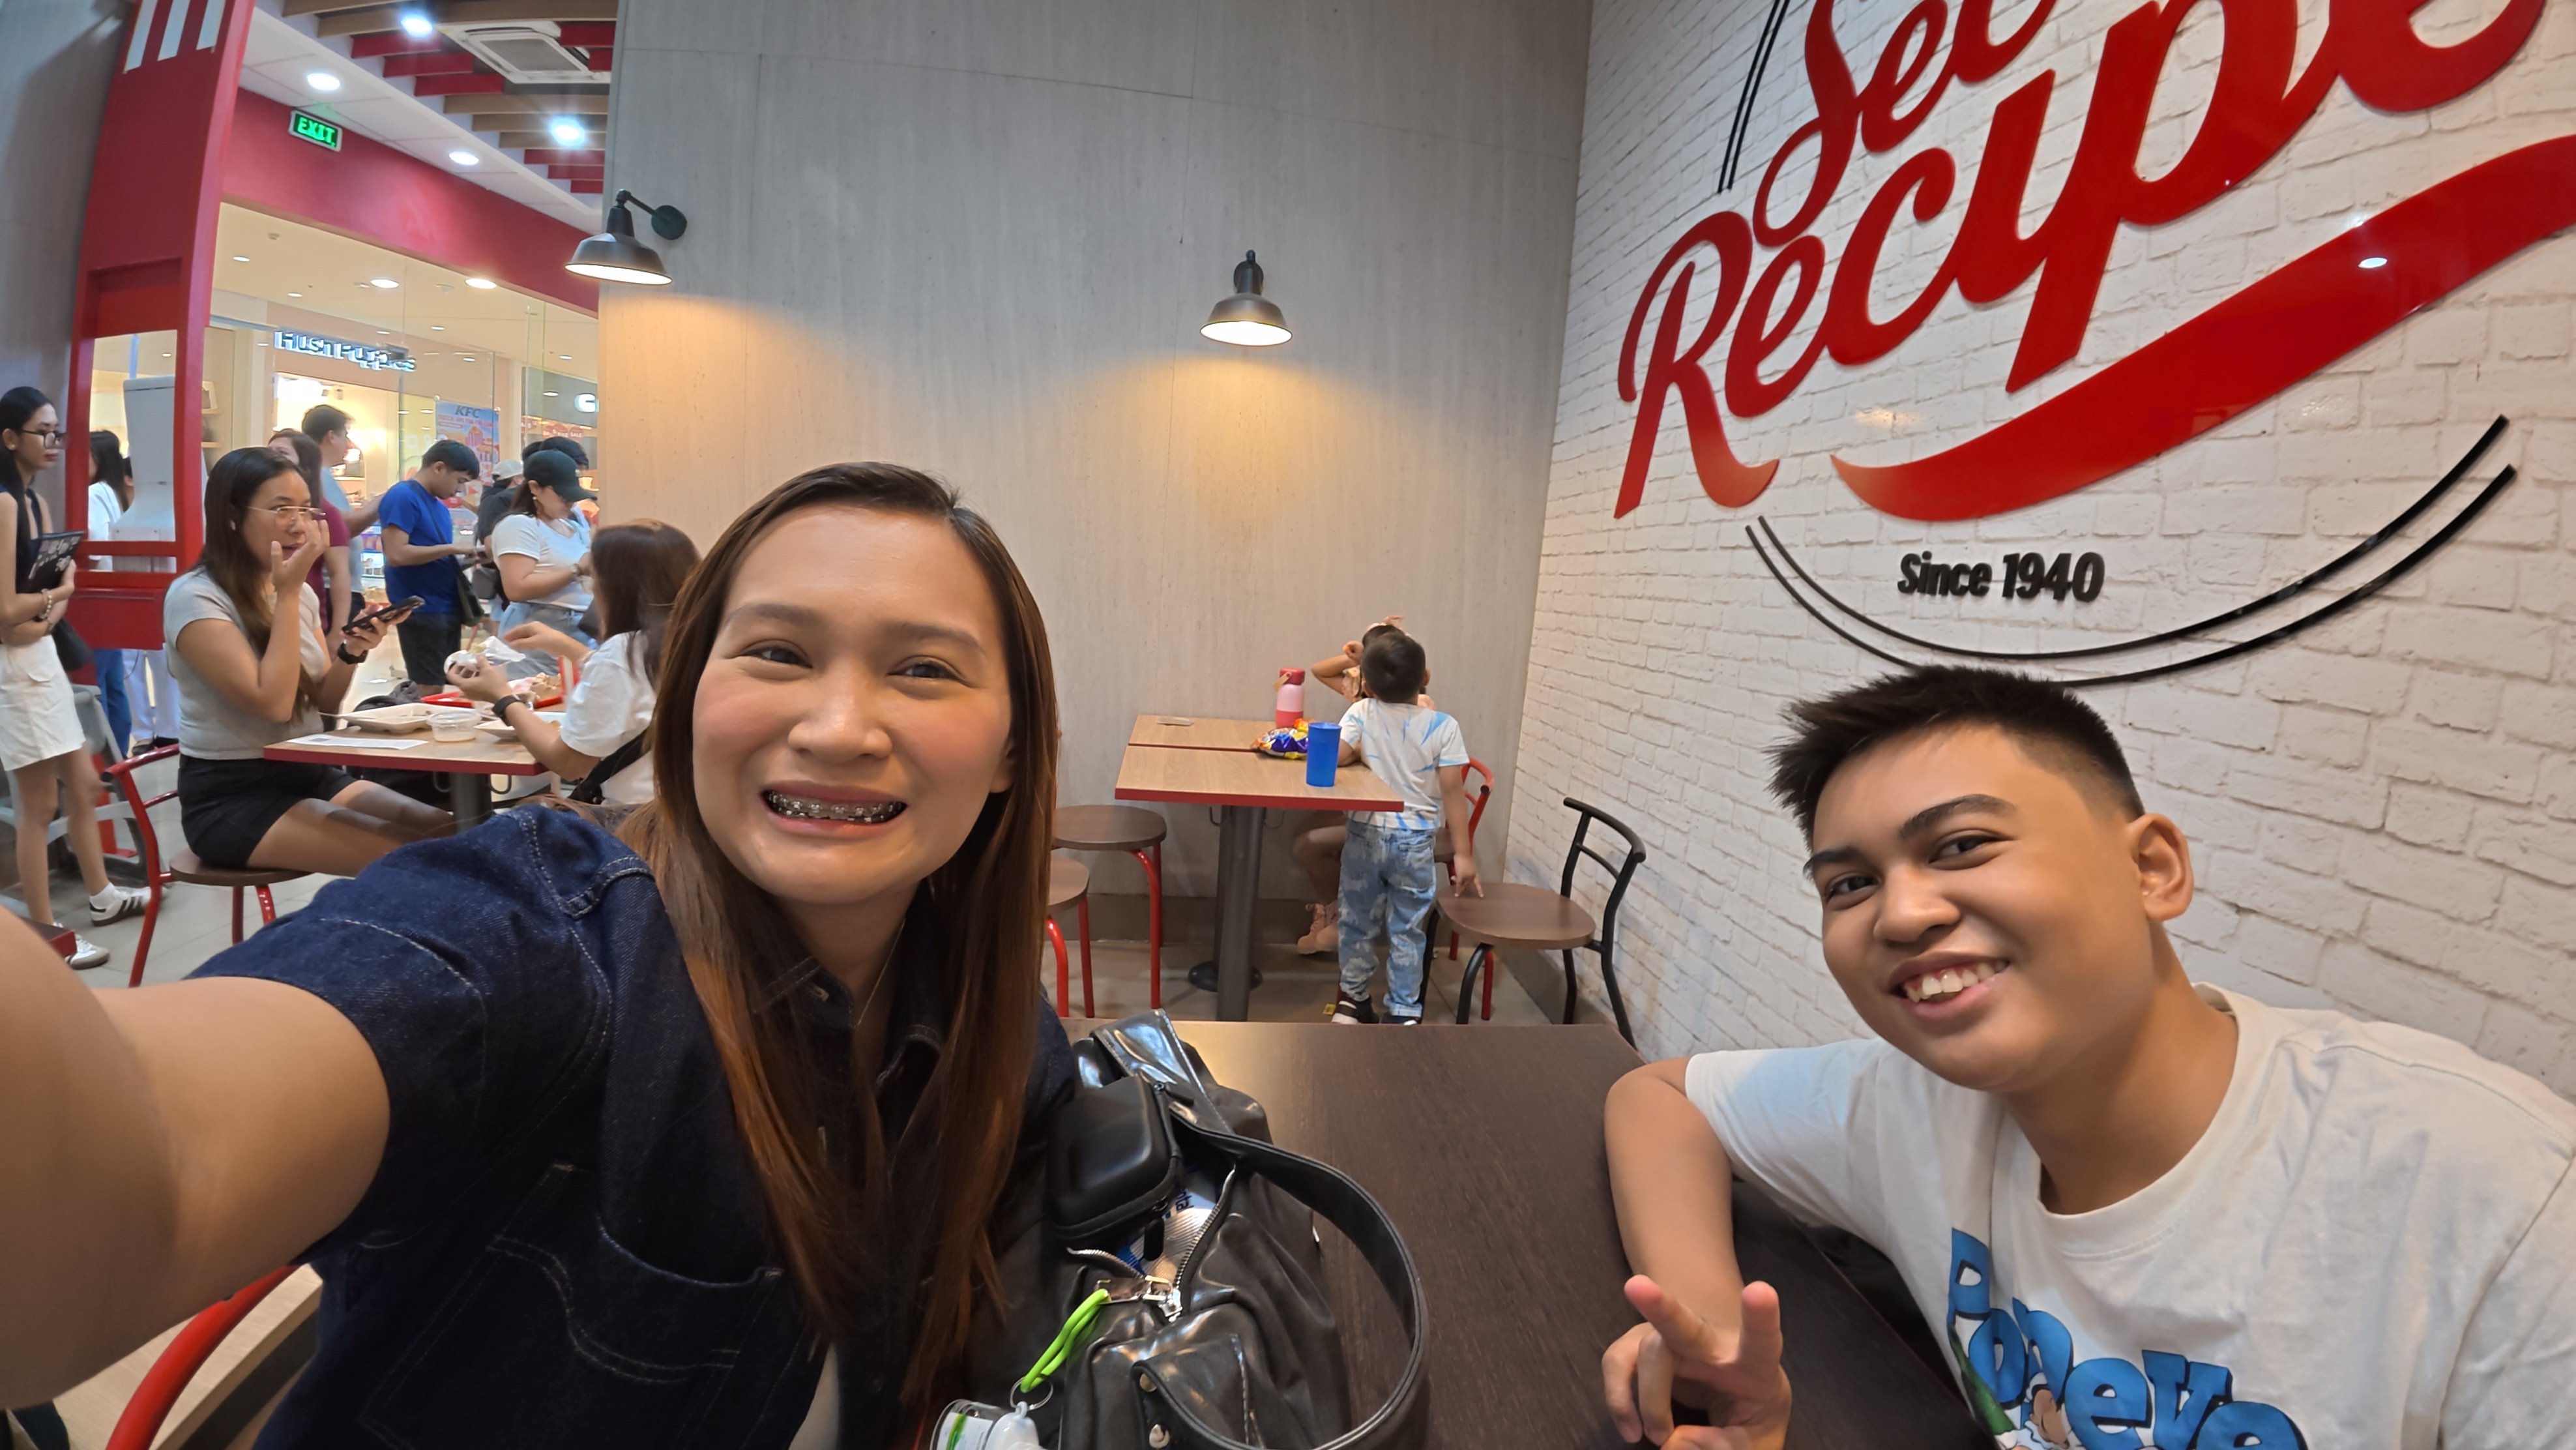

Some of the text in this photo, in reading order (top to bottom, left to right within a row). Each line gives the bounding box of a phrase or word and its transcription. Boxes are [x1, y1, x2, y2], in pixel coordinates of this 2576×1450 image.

[297, 117, 336, 143] EXIT
[274, 331, 417, 372] Hush Puppes
[455, 405, 481, 419] KFC
[1897, 551, 2105, 603] Since 1940
